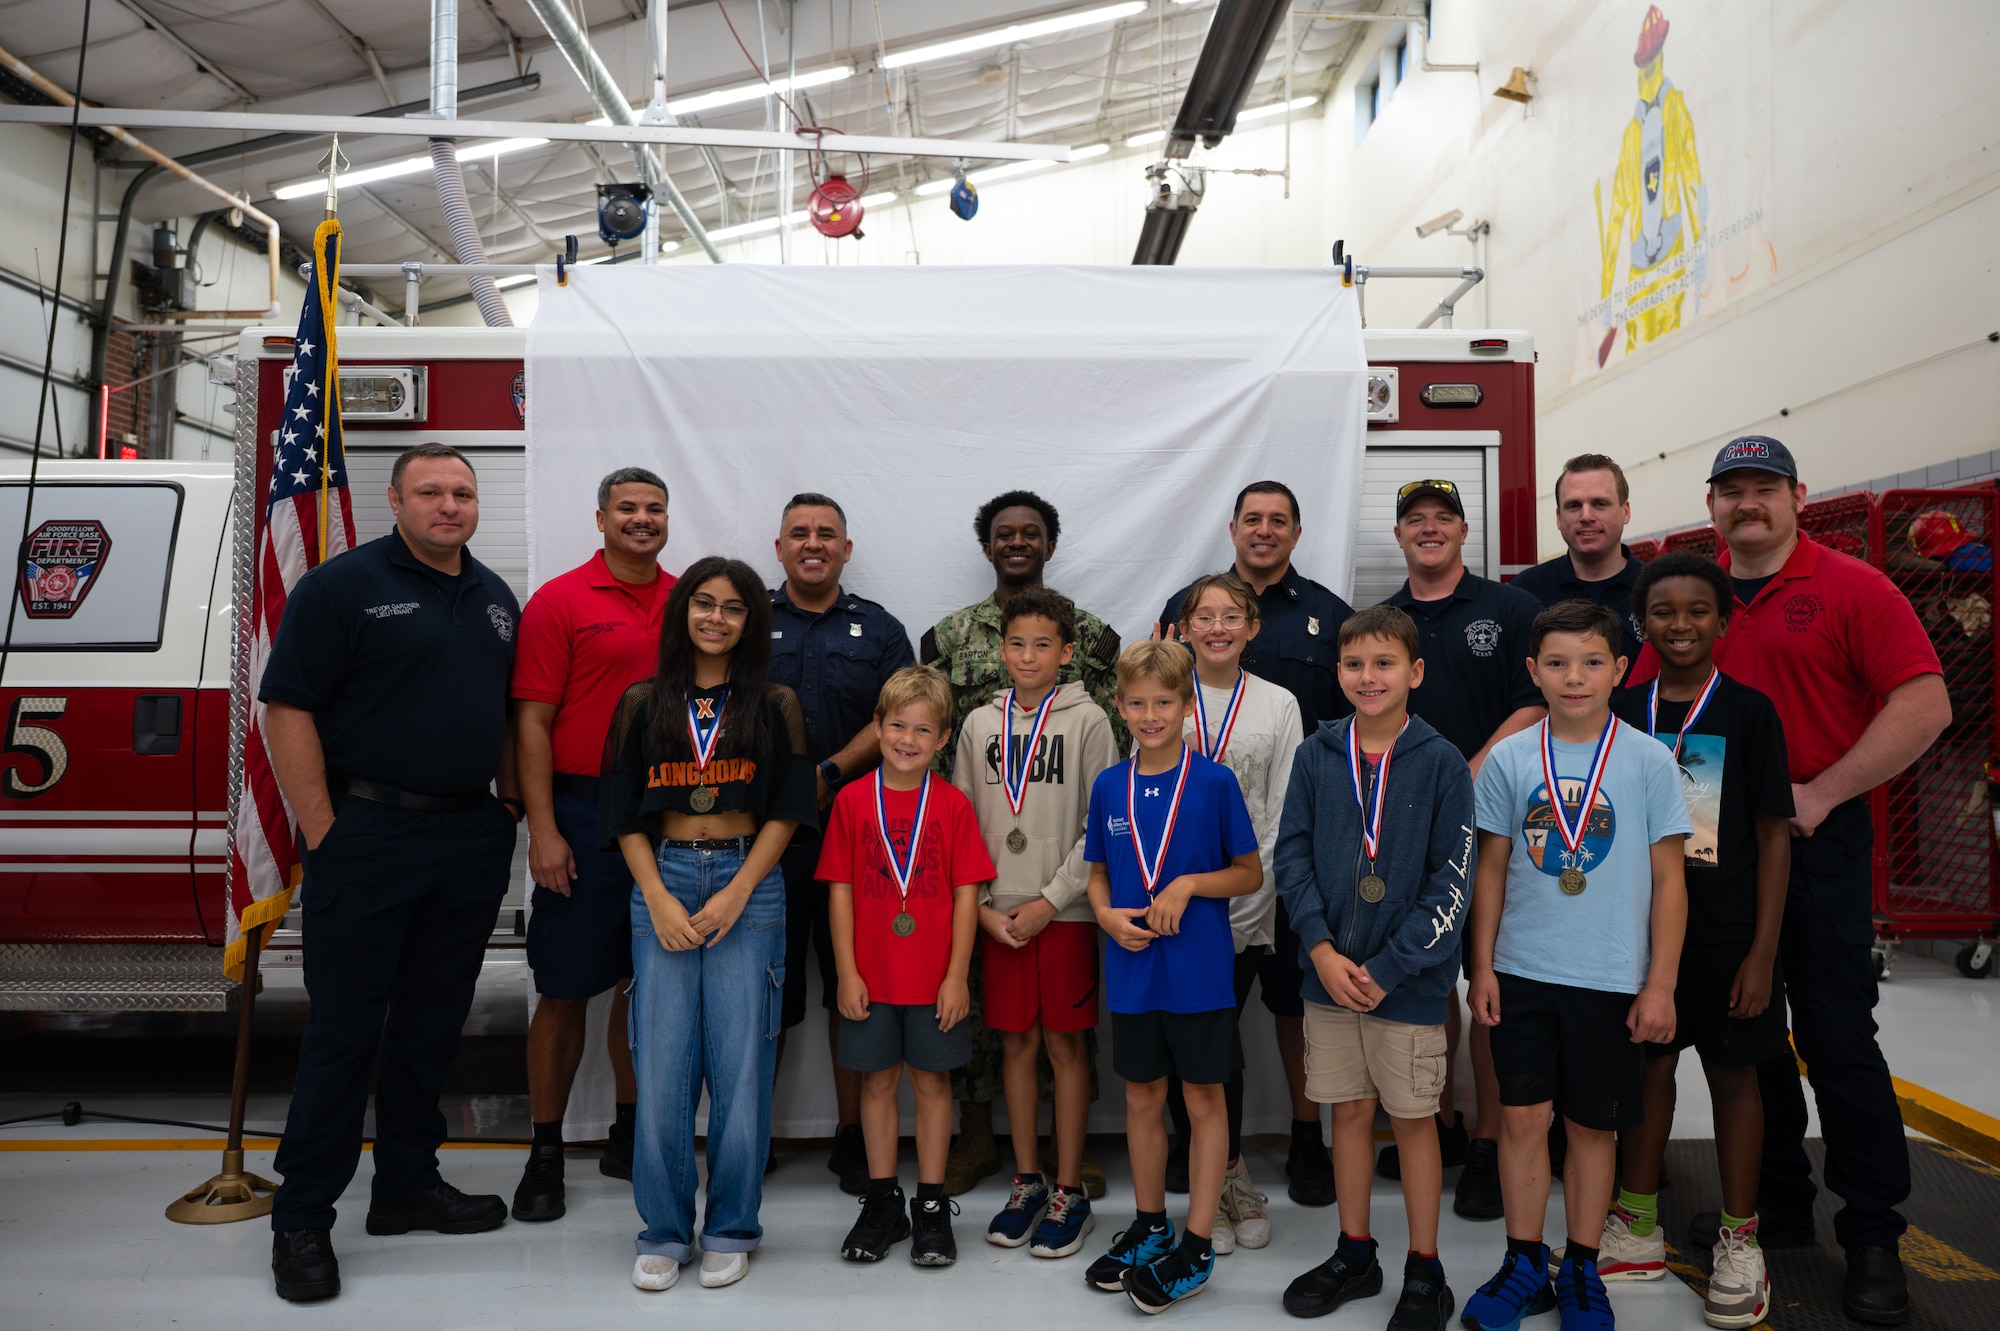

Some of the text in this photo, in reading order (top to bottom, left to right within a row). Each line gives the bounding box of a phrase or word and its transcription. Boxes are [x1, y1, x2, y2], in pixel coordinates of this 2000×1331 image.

[1577, 207, 1763, 328] THE DESIRE TO SERVE THE ABILITY TO PERFORM
[1615, 271, 1695, 328] THE COURAGE TO ACT
[29, 537, 102, 558] FIRE
[32, 602, 72, 610] EST. 1941
[365, 602, 421, 615] TREVOR GARDNER
[376, 608, 413, 619] LIEUTENANT
[959, 650, 989, 660] BARTON
[5, 696, 68, 798] 5
[648, 758, 757, 788] LONGHORNS
[1407, 1279, 1432, 1296] NIKE
